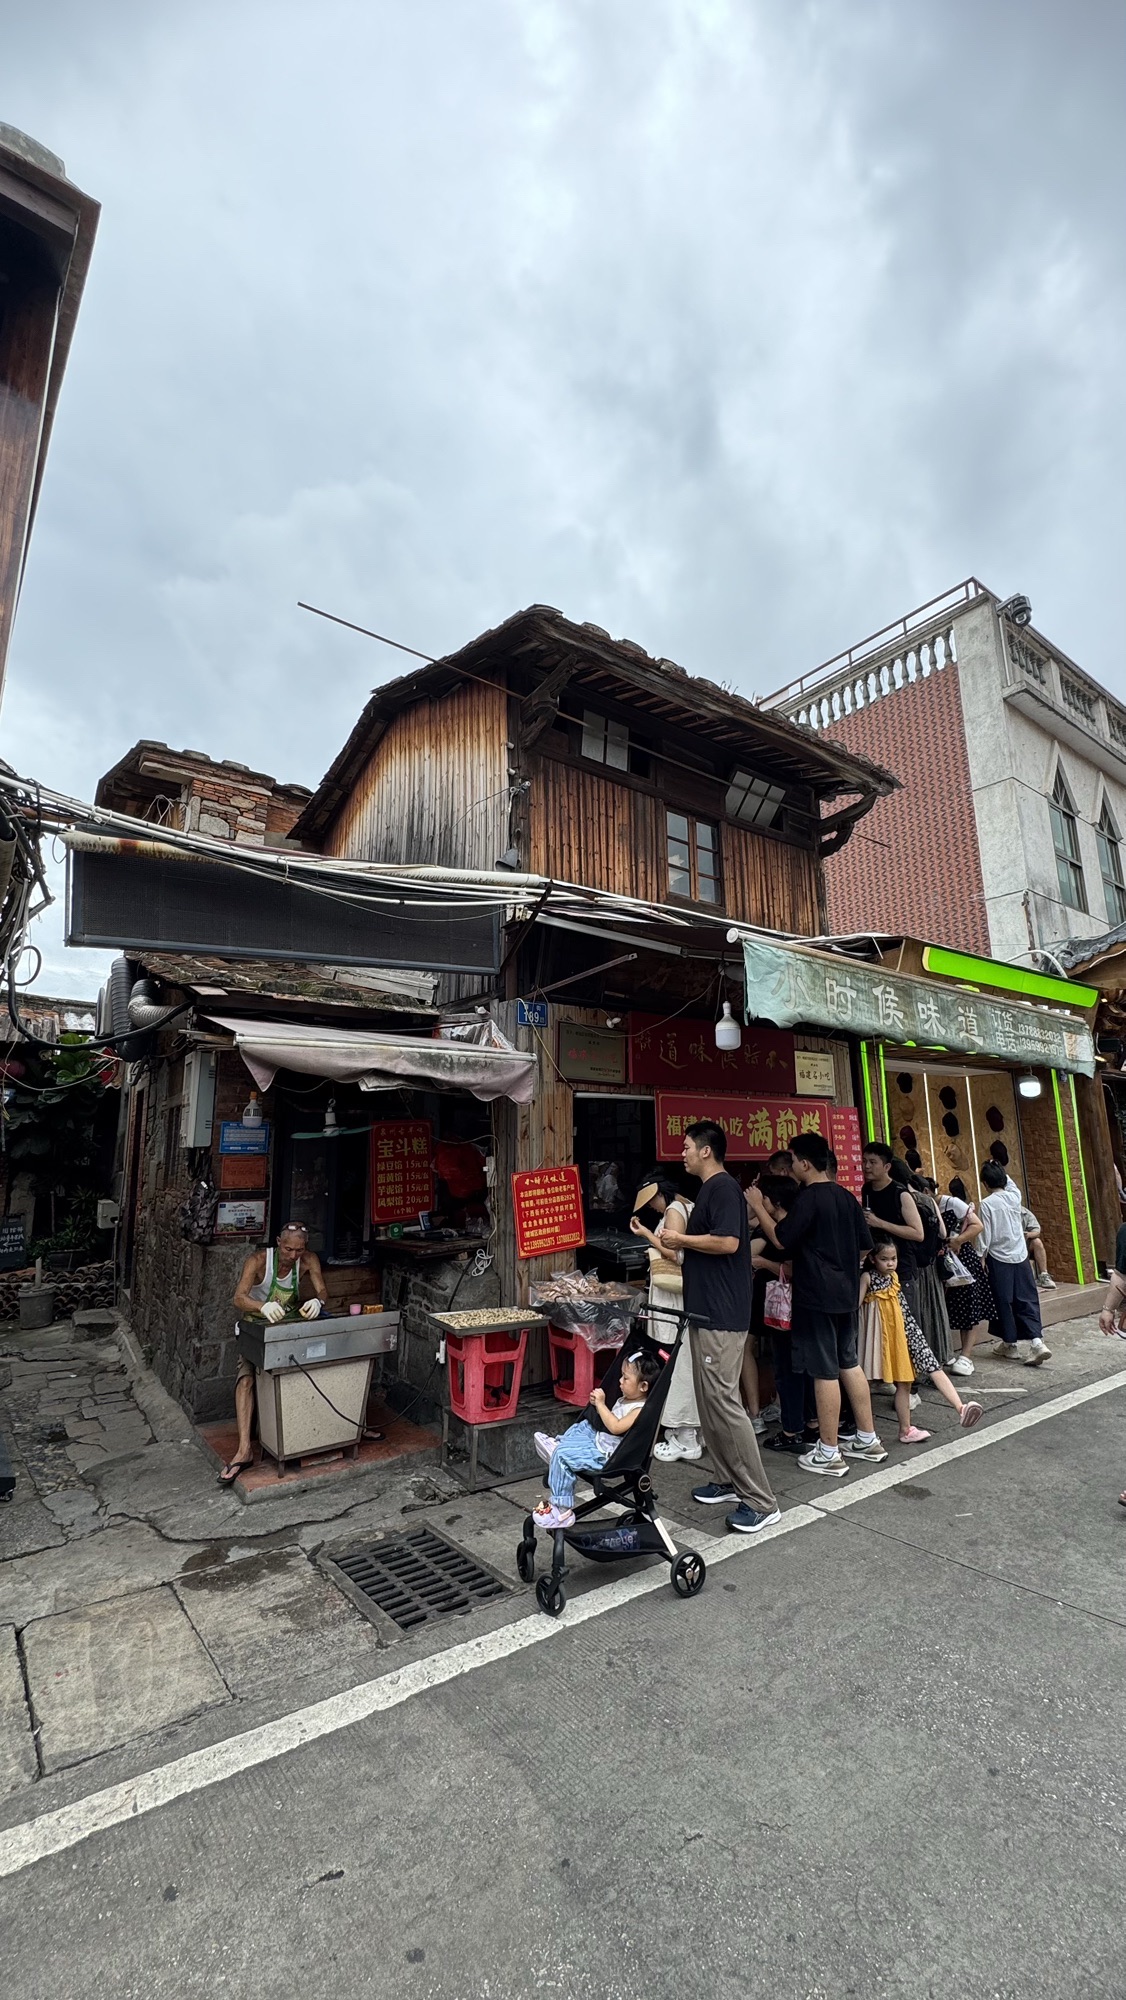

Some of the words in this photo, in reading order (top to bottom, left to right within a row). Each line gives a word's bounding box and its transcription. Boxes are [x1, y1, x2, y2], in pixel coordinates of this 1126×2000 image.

[770, 962, 984, 1047] 小时候味道
[991, 1008, 1014, 1033] 订货
[996, 1032, 1018, 1053] 电话
[377, 1137, 428, 1158] 宝斗糕
[377, 1172, 403, 1184] 蛋黄馅
